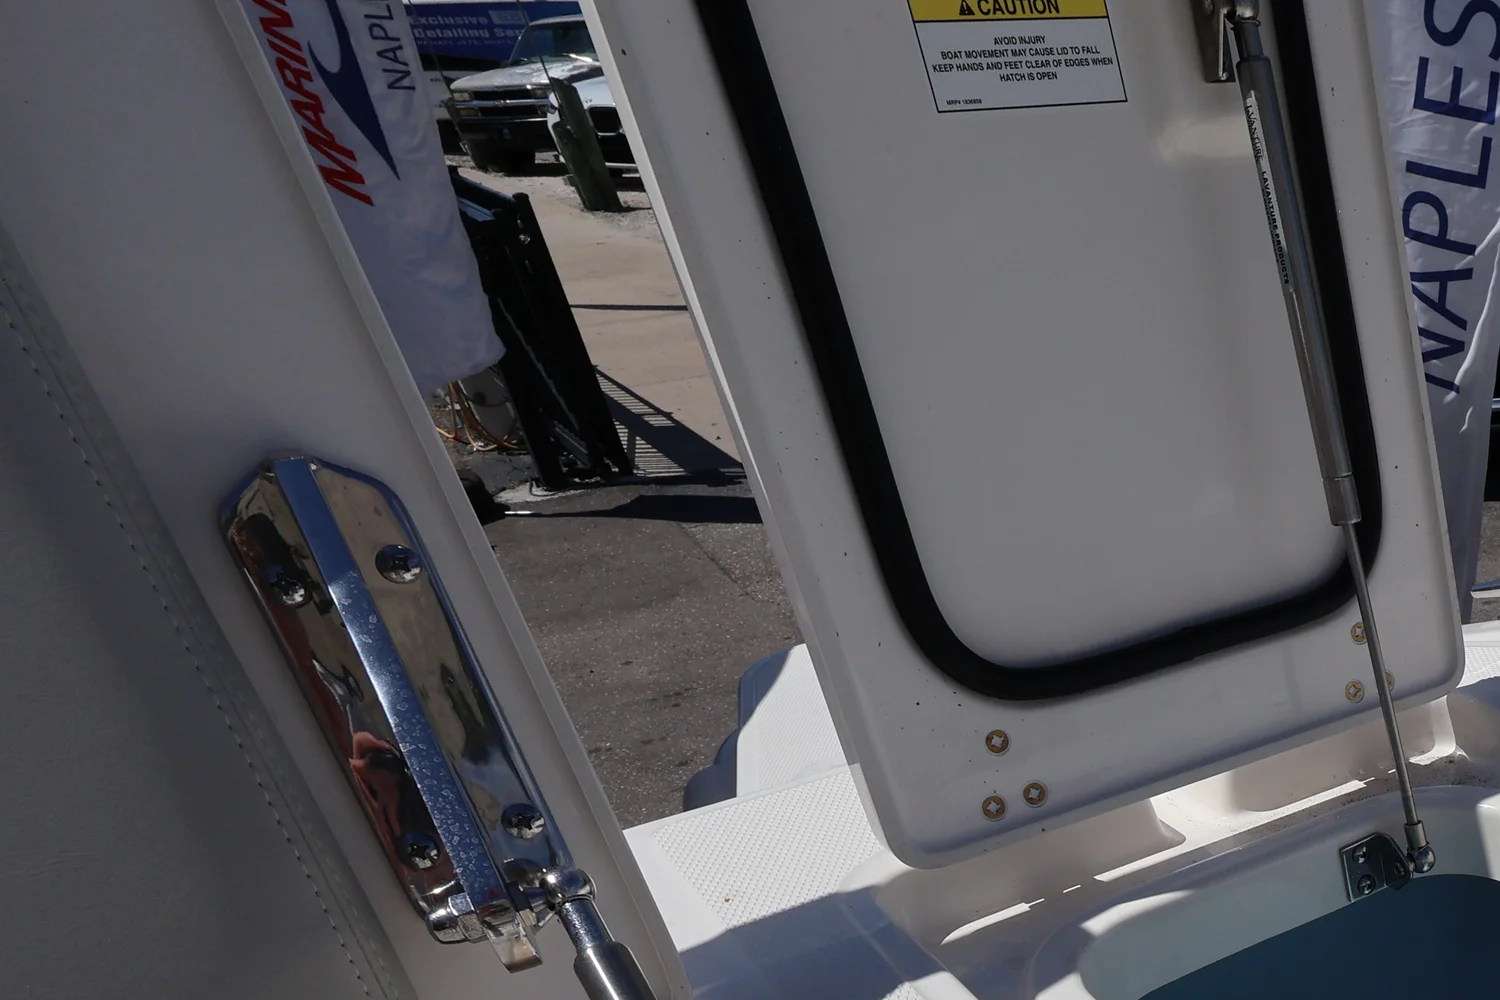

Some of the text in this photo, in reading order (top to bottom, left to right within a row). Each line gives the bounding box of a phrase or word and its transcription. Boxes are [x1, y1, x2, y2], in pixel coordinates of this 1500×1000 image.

[977, 0, 1061, 16] CAUTION
[410, 15, 488, 26] Exclusive
[412, 28, 490, 39] Detailing
[993, 35, 1046, 46] AVOID INJURY
[364, 0, 416, 90] NAPL
[940, 46, 1100, 60] BOAT MOVEMENT MAY CAUSE LID TO FALL
[931, 57, 1114, 73] KEEP HANDS AND FEET CLEAR OF EDGES WHEN
[999, 71, 1058, 82] HATCH IS OPEN
[252, 0, 375, 207] MARIN
[1261, 170, 1290, 285] LAVANTURE PRODUCTS
